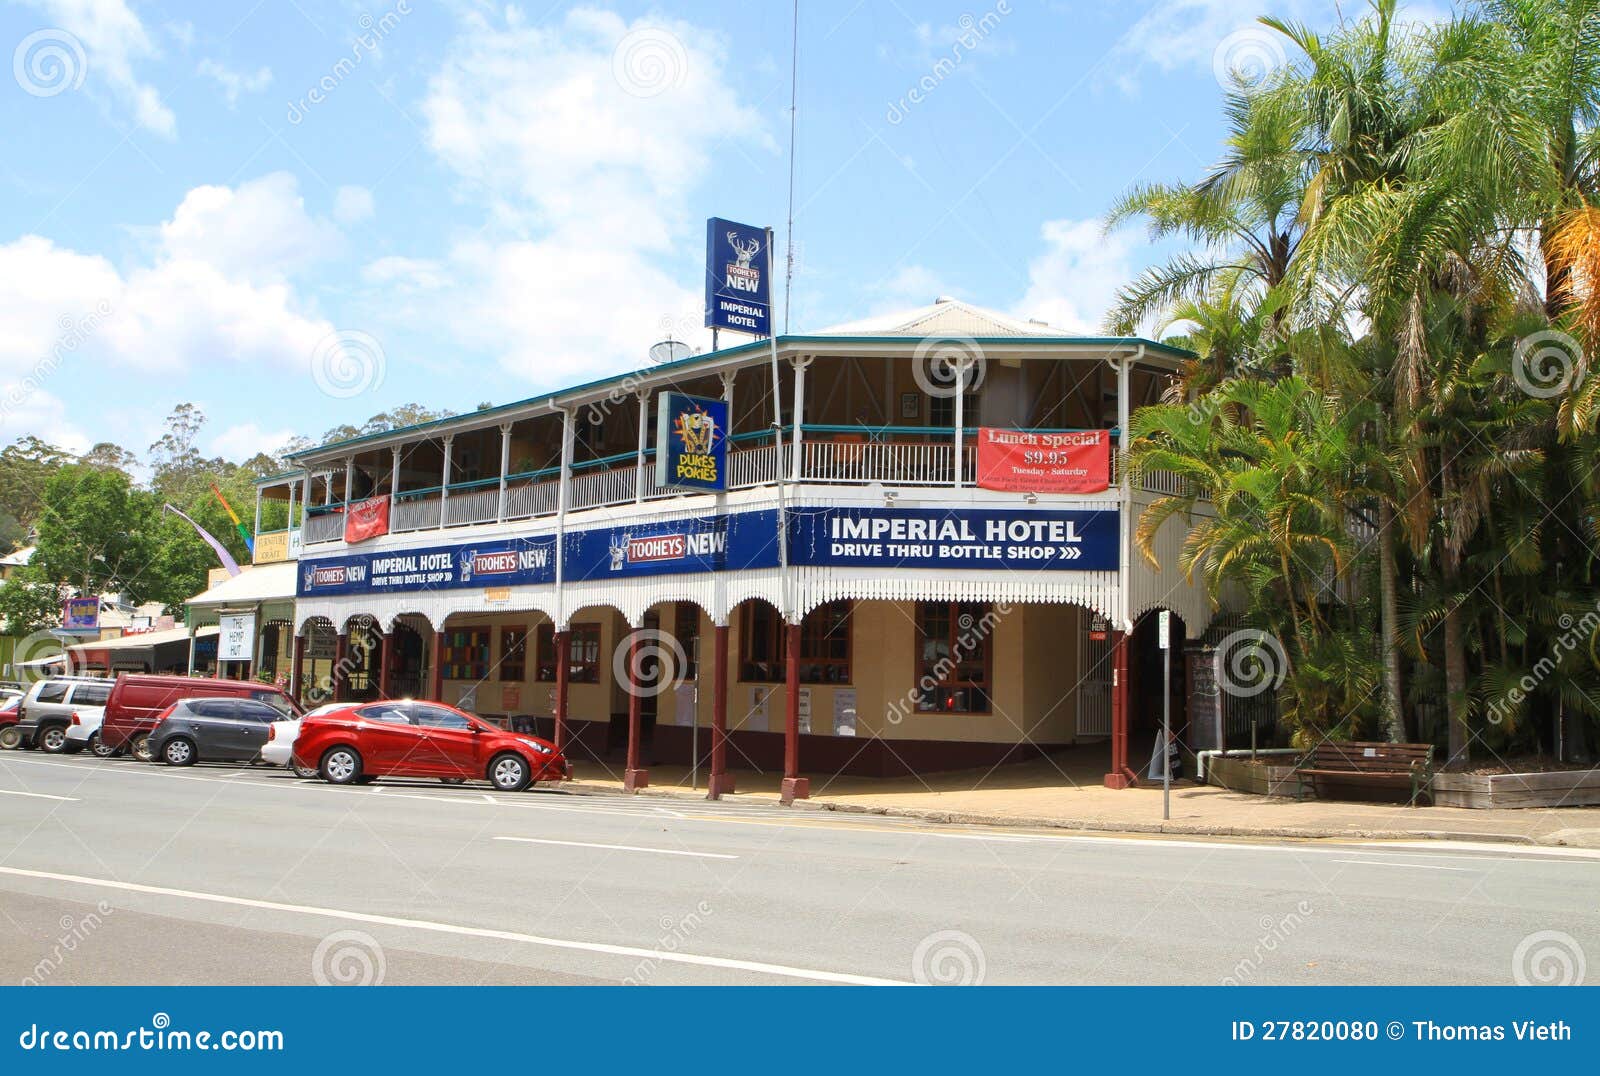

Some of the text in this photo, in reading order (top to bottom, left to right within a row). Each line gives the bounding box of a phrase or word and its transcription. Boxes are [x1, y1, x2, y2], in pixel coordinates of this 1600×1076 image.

[729, 266, 758, 278] TOOHEYS
[726, 275, 760, 293] NEW
[720, 301, 765, 318] IMPERIAL
[727, 314, 757, 328] HOTEL
[988, 430, 1100, 448] Lunch Special
[679, 455, 716, 469] DUKES
[1024, 449, 1068, 465] $9.95
[677, 465, 717, 481] POKIES
[1012, 466, 1044, 476] Tuesday
[1051, 467, 1088, 476] Saturday
[831, 518, 1082, 542] IMPERIAL HOTEL
[631, 531, 726, 558] TOOHEYS NEW
[831, 543, 1056, 560] DRIVE THRU BOTTLE SHOP
[372, 553, 453, 575] IMPERIAL HOTEL
[476, 549, 549, 571] TOOHEYS NEW
[315, 566, 367, 583] TOOHEYS NEW
[371, 572, 444, 586] DRIVE THRU BOTTLE SHOP
[232, 617, 244, 629] THE
